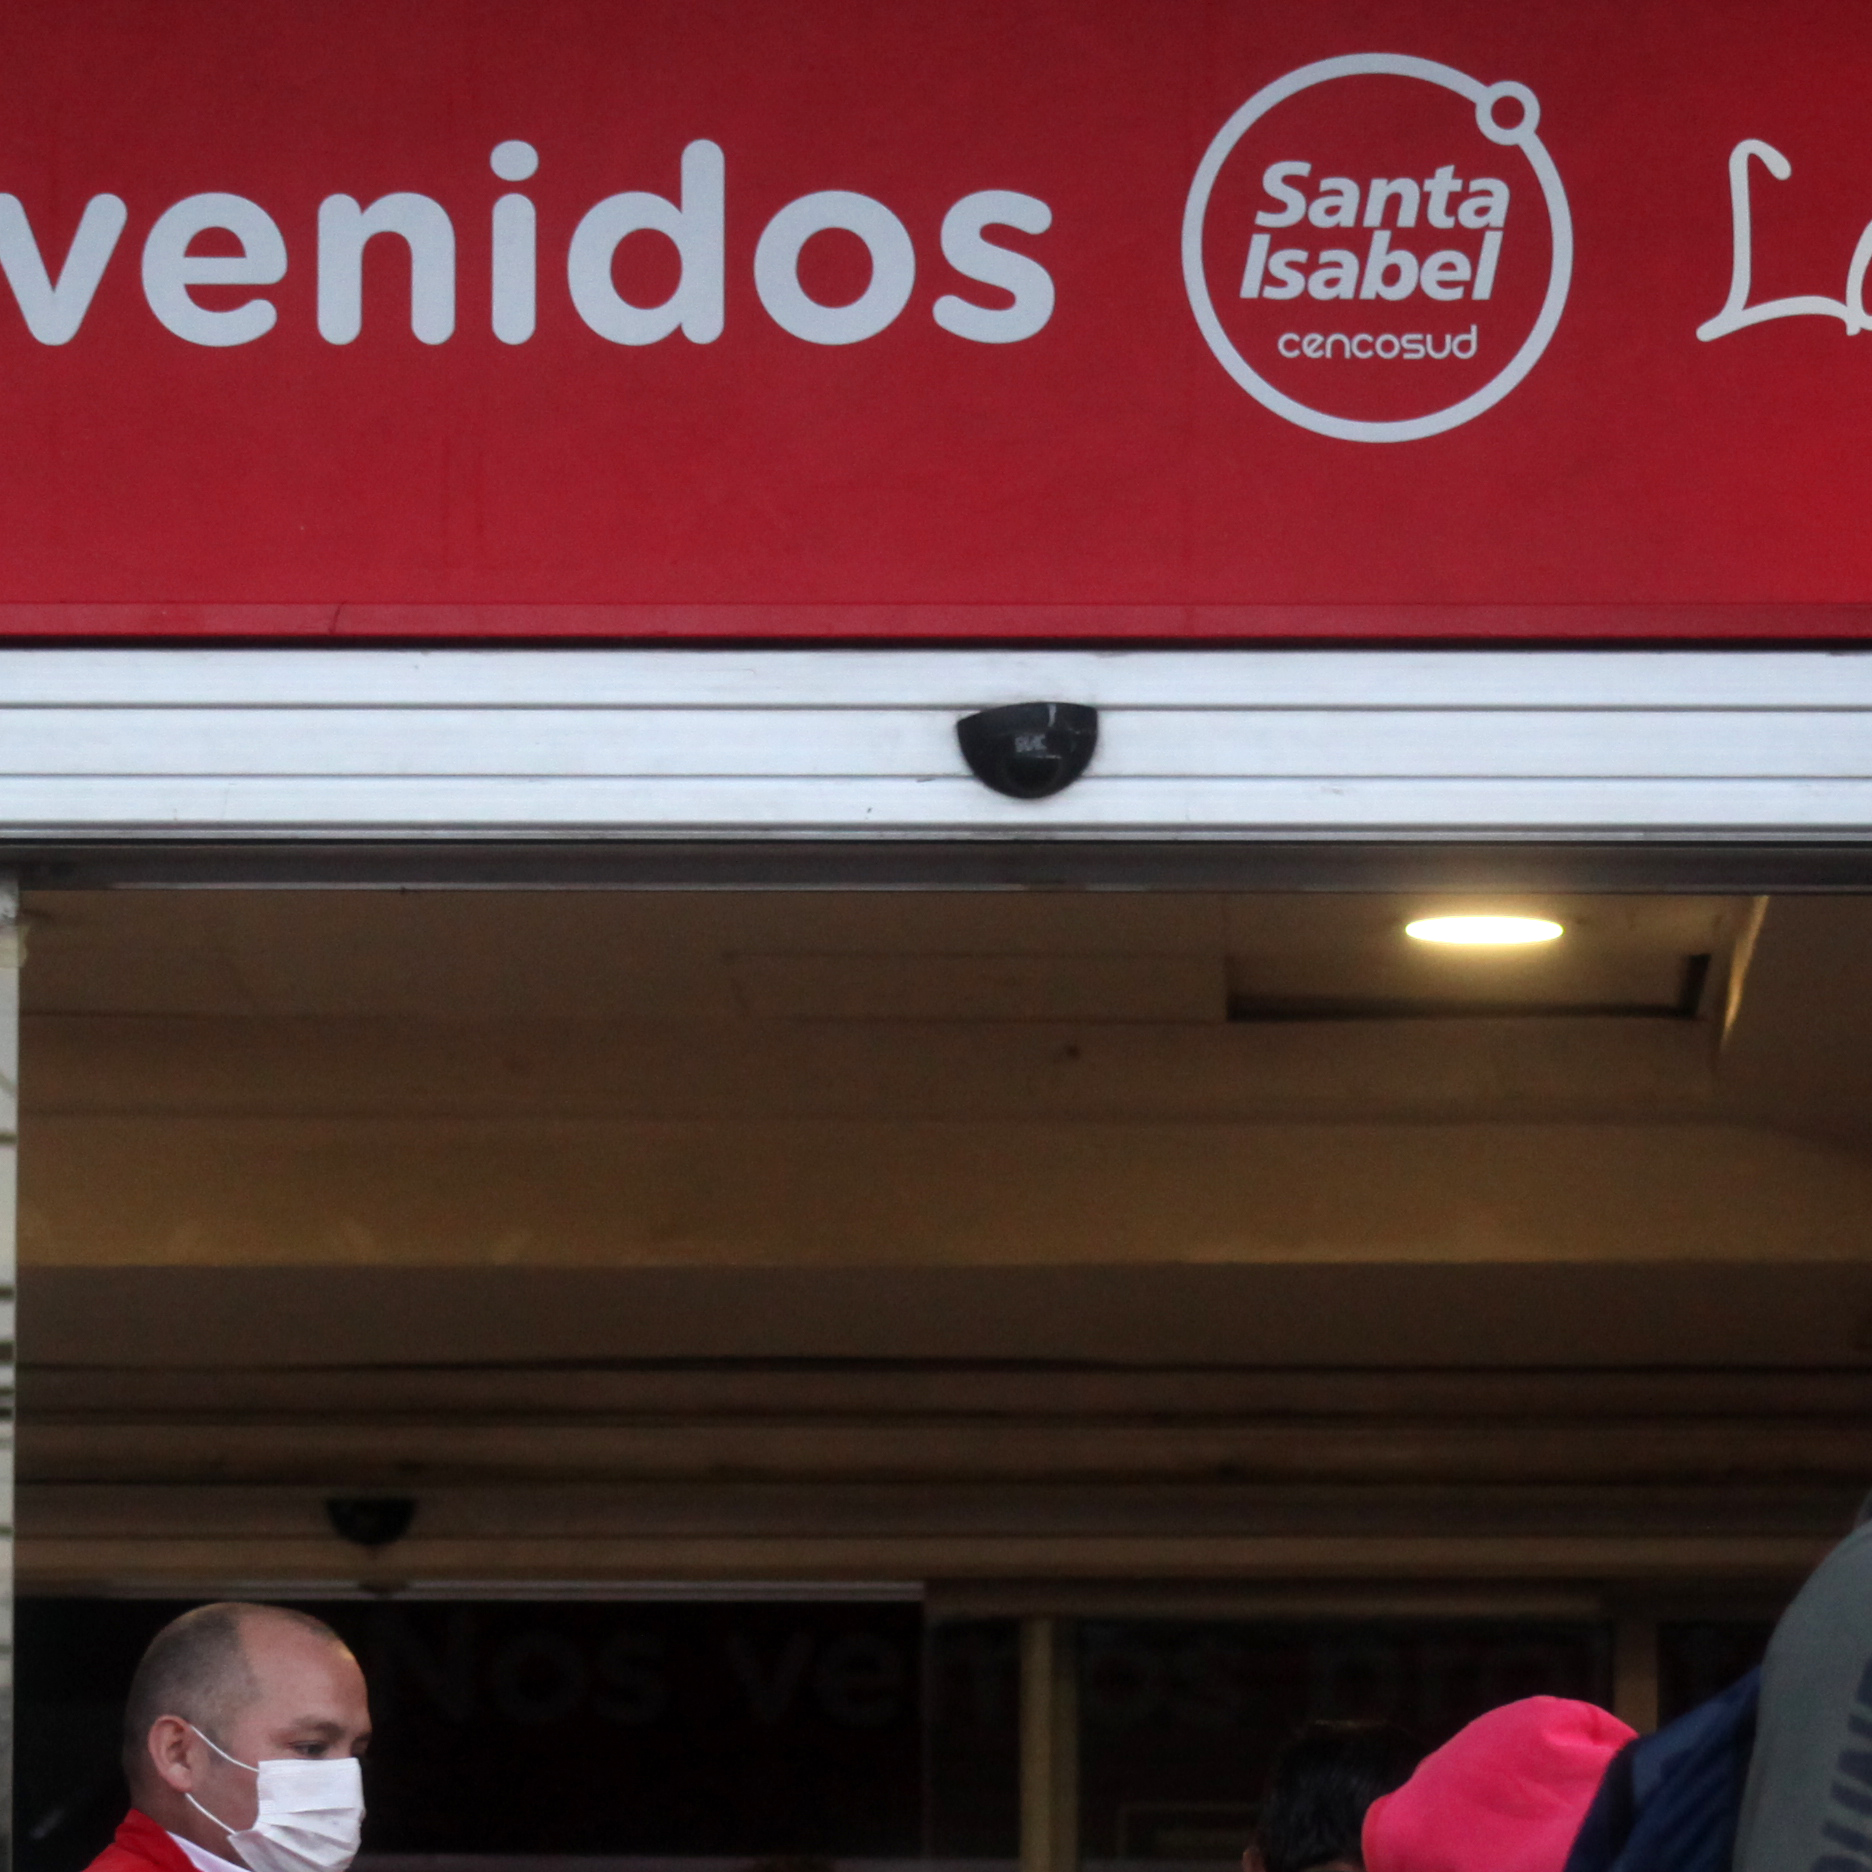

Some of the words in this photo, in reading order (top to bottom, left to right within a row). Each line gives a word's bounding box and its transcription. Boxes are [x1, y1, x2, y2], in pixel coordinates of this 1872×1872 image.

[1254, 160, 1510, 229] Santa
[1239, 230, 1504, 301] Isabel
[1277, 324, 1478, 360] cencosud
